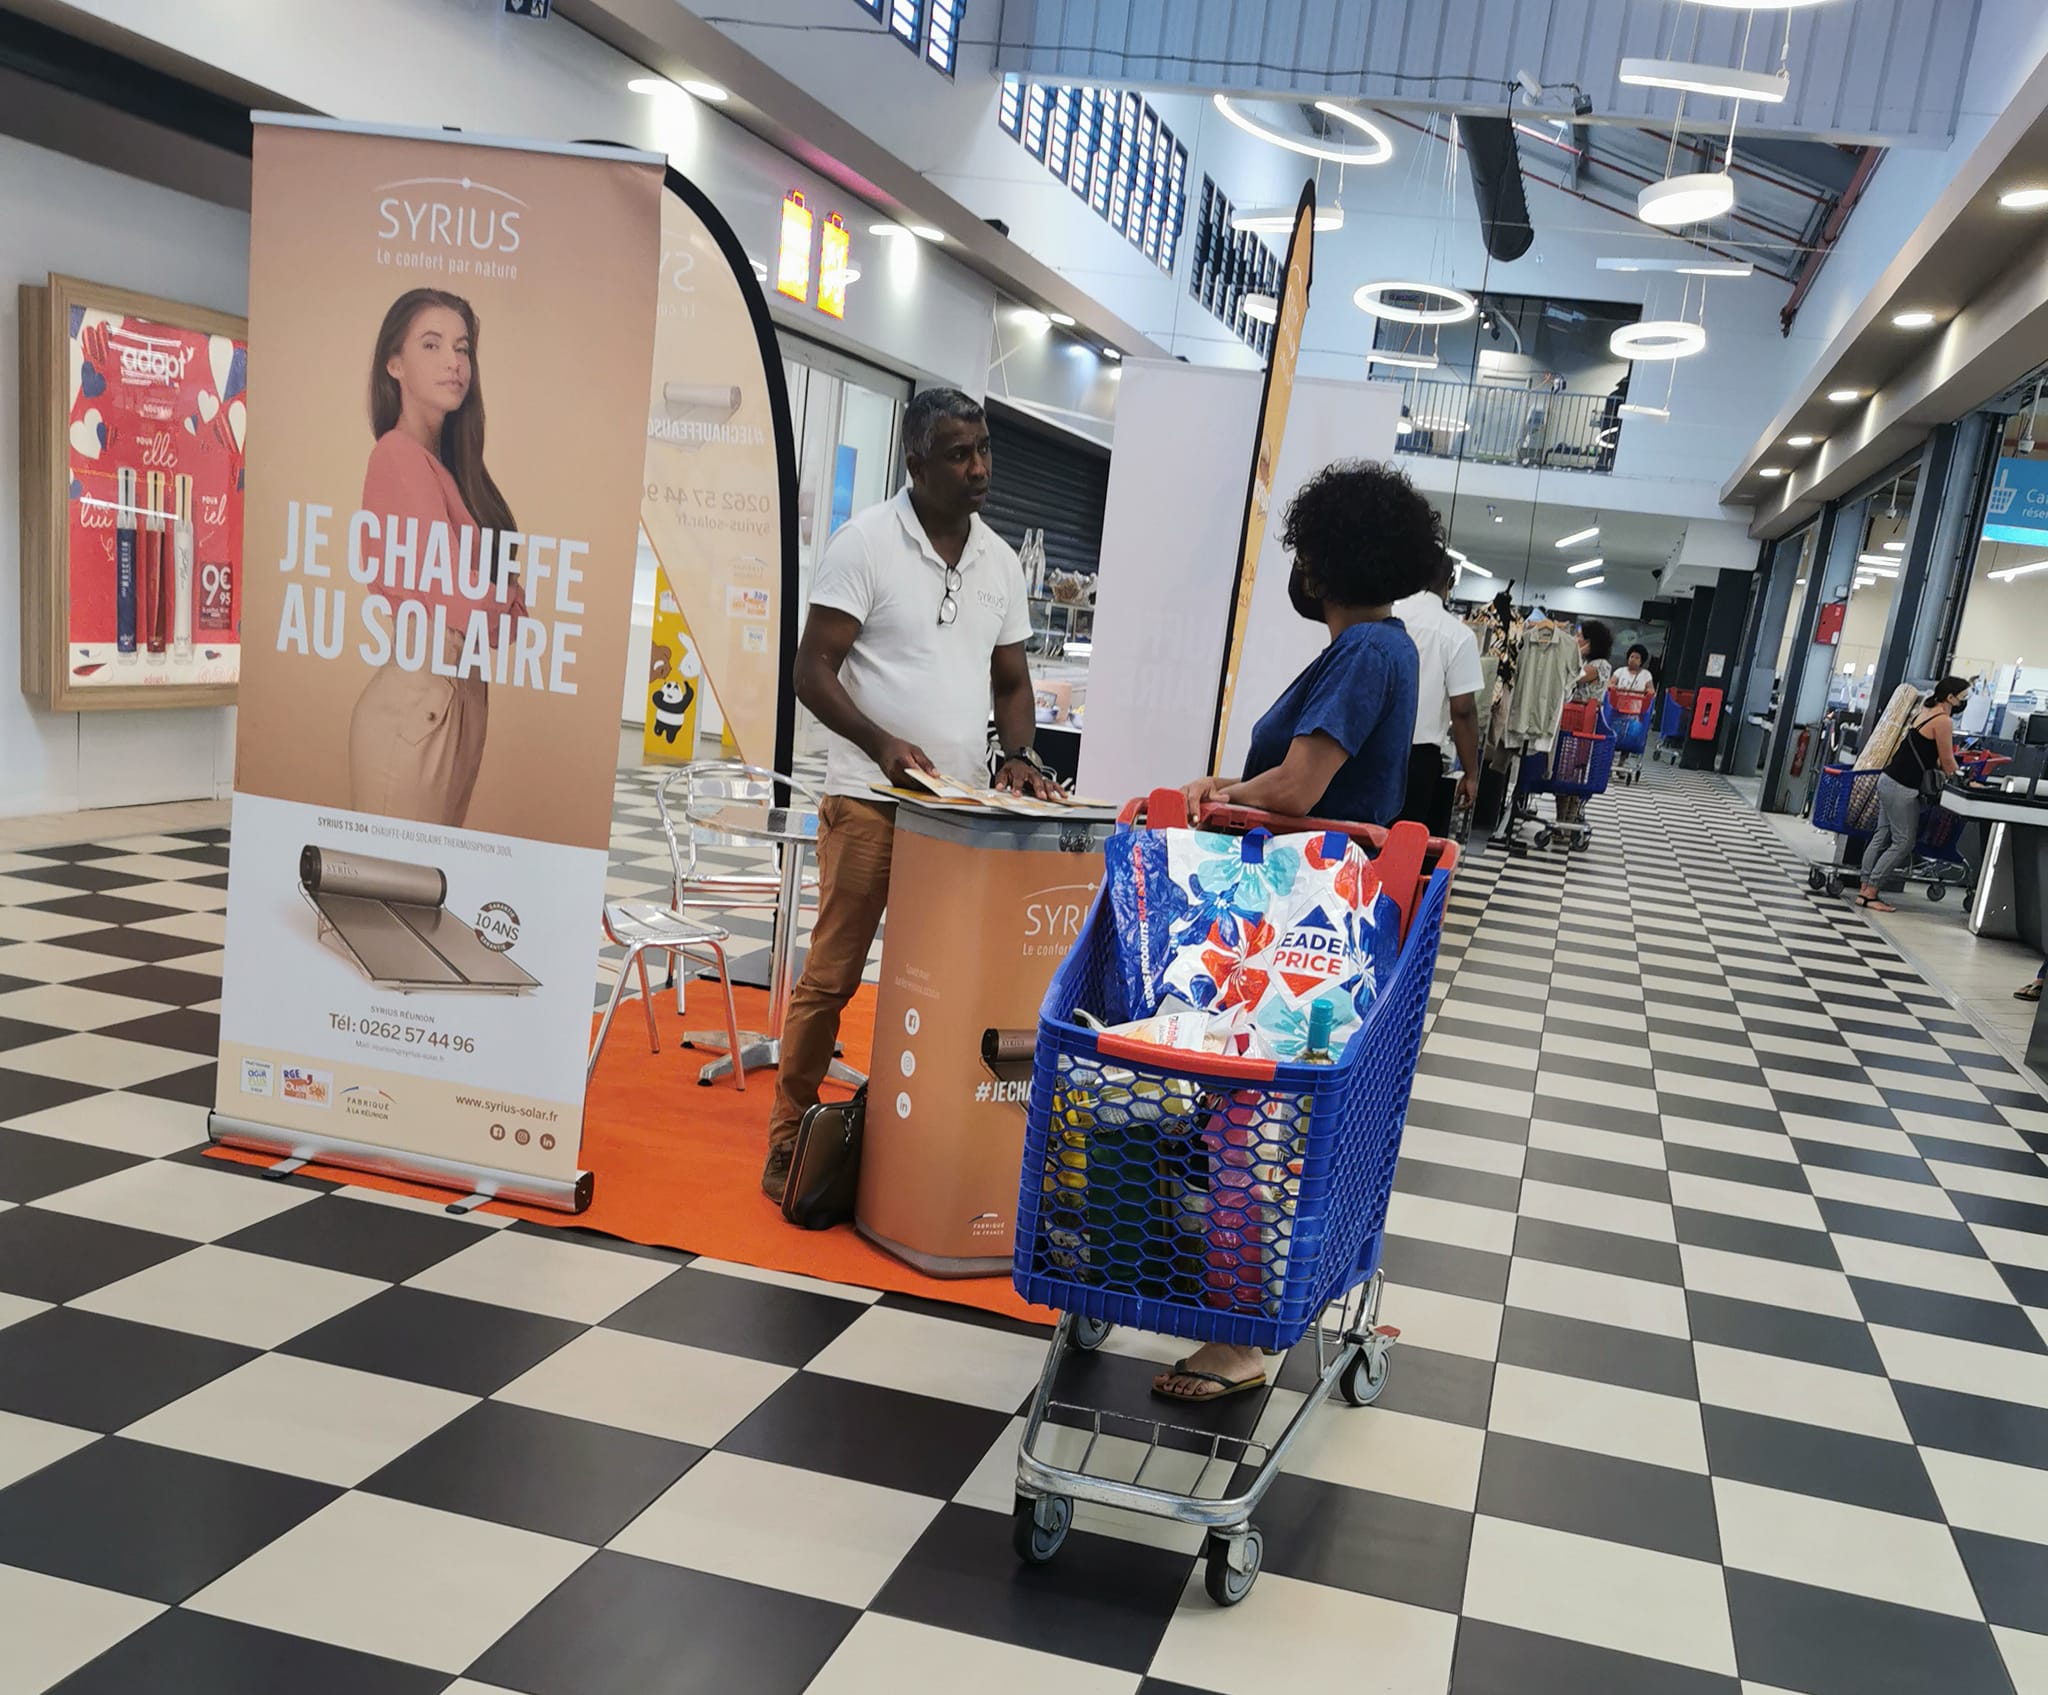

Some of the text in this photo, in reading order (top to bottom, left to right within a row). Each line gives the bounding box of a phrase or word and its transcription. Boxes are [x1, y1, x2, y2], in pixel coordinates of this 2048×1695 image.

[378, 198, 520, 253] SYRIUS
[377, 248, 518, 280] Le confort par nature
[143, 431, 178, 468] elle
[80, 491, 113, 528] lui
[2026, 488, 2048, 505] Ca
[279, 501, 333, 577] JE
[347, 509, 590, 614] CHAUFFE
[276, 582, 583, 695] AU SOLAIRE
[317, 817, 344, 830] SYRIUS
[344, 821, 354, 831] TS
[354, 822, 369, 833] 304
[415, 831, 443, 846] SOLAIRE
[443, 836, 495, 852] THERMOSIPHON
[475, 913, 520, 941] 10 ANS
[1024, 904, 1089, 935] SYRI
[1023, 943, 1034, 956] Le
[1140, 921, 1151, 974] PRODUITS
[1273, 950, 1343, 976] PRICE
[370, 1006, 435, 1024] SYRIUS RÉUNION
[359, 1018, 401, 1041] 0262
[404, 1027, 426, 1044] 57
[427, 1031, 450, 1049] 44
[452, 1035, 475, 1054] 96
[283, 1069, 300, 1079] RGE
[456, 1096, 559, 1122] www.syrius-solar.fr
